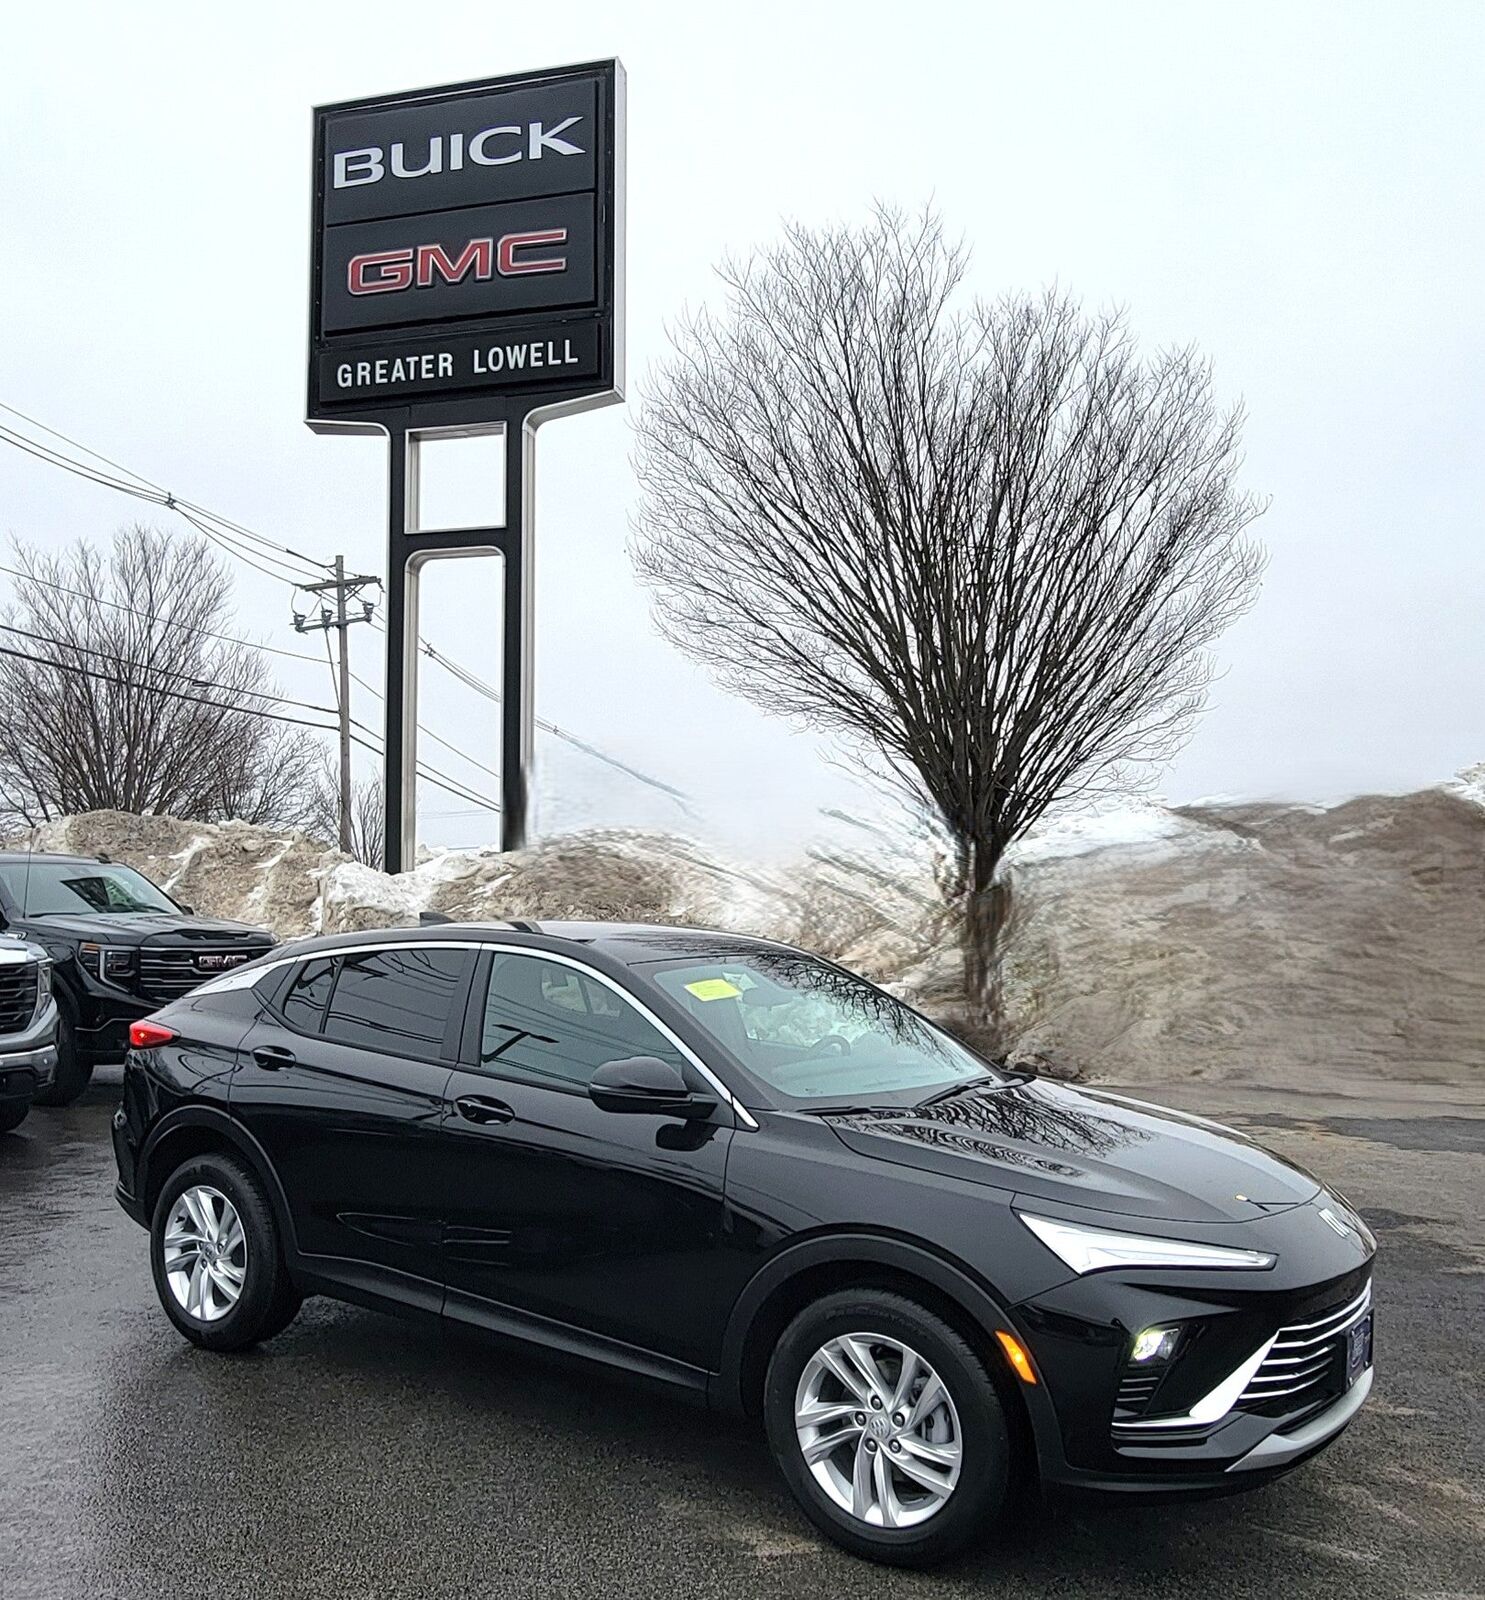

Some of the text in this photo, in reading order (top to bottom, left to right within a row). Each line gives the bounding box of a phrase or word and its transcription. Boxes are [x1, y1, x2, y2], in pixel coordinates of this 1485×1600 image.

[333, 116, 586, 189] BUICK
[347, 228, 567, 296] GMC
[336, 339, 579, 388] GREATER LOWELL
[198, 954, 248, 968] GMC
